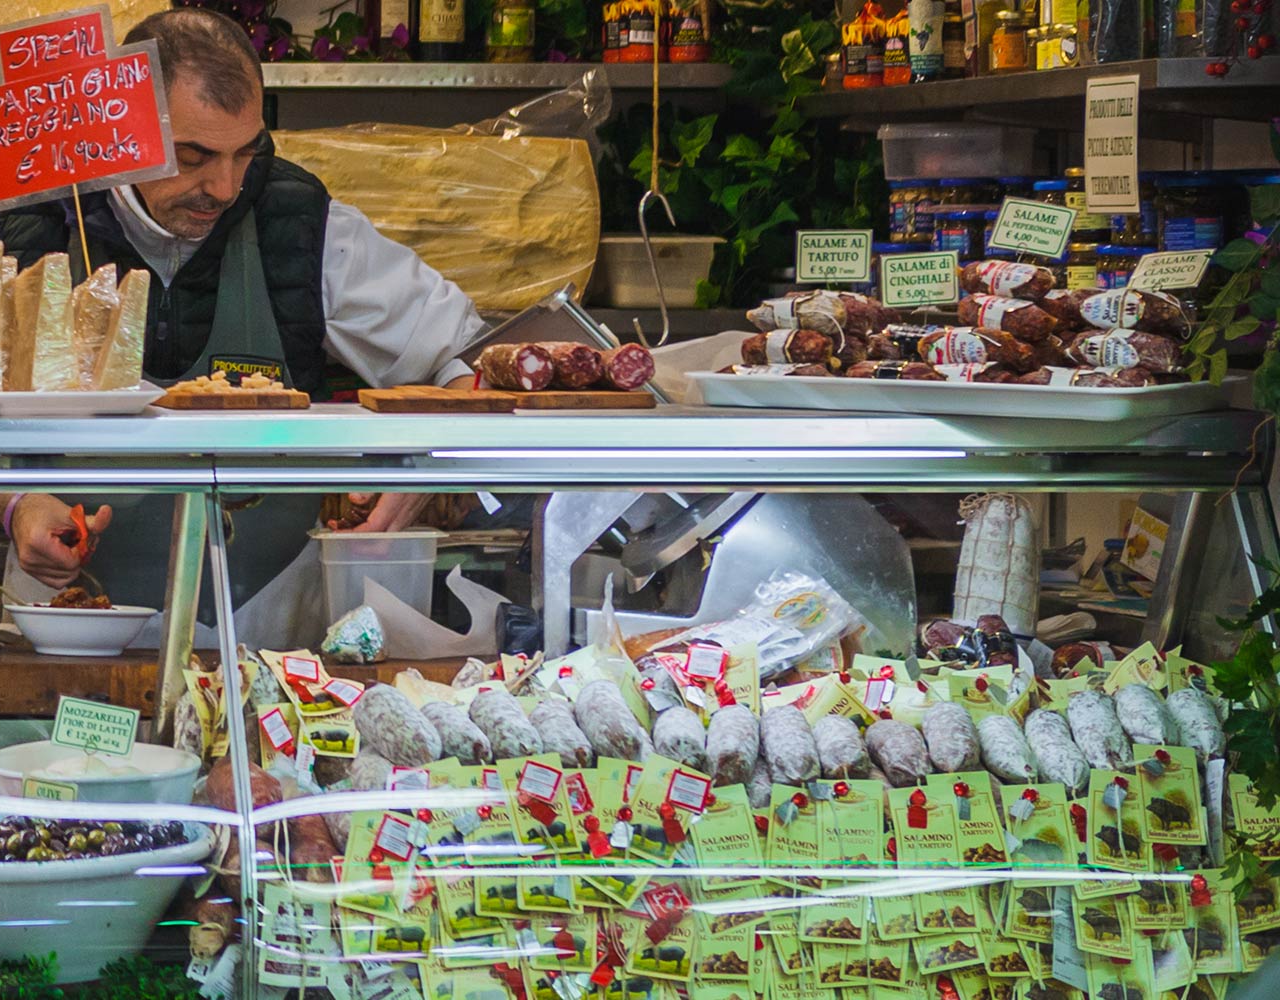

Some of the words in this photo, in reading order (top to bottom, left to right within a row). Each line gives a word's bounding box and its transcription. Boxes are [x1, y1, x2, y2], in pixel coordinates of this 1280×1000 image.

[7, 22, 105, 70] SPECIAL
[1090, 98, 1116, 119] PRODOTTI
[1117, 97, 1133, 117] DELLE
[1088, 137, 1109, 157] PICCOLE
[1110, 136, 1133, 156] AZIENDE
[16, 144, 42, 184] €
[1091, 175, 1131, 195] TERREMOTATE
[1013, 209, 1058, 225] SALAME
[1001, 220, 1010, 228] AL
[1012, 222, 1063, 237] PEPERONCINO
[1006, 230, 1011, 239] €
[1013, 232, 1032, 242] 4,00
[802, 238, 847, 249] SALAME
[850, 238, 864, 248] AL
[808, 252, 859, 262] TARTUFO
[1150, 254, 1198, 267] SALAME
[818, 265, 837, 275] 5,00
[890, 260, 937, 273] SALAME
[939, 258, 950, 269] di
[1143, 264, 1196, 277] CLASSICO
[889, 273, 950, 287] CINGHIALE
[906, 289, 925, 299] 5,00
[213, 360, 281, 377] PROSCIUTTERA
[64, 706, 132, 725] MOZZARELLA
[63, 717, 83, 728] FIOR
[87, 721, 96, 729] DI
[99, 723, 128, 737] LATTE
[37, 786, 62, 801] OLIVE
[702, 833, 749, 846] SALAMINO
[775, 836, 819, 850] SALAMIN
[904, 834, 953, 842] SALAMINO
[717, 842, 750, 852] TARTUFO
